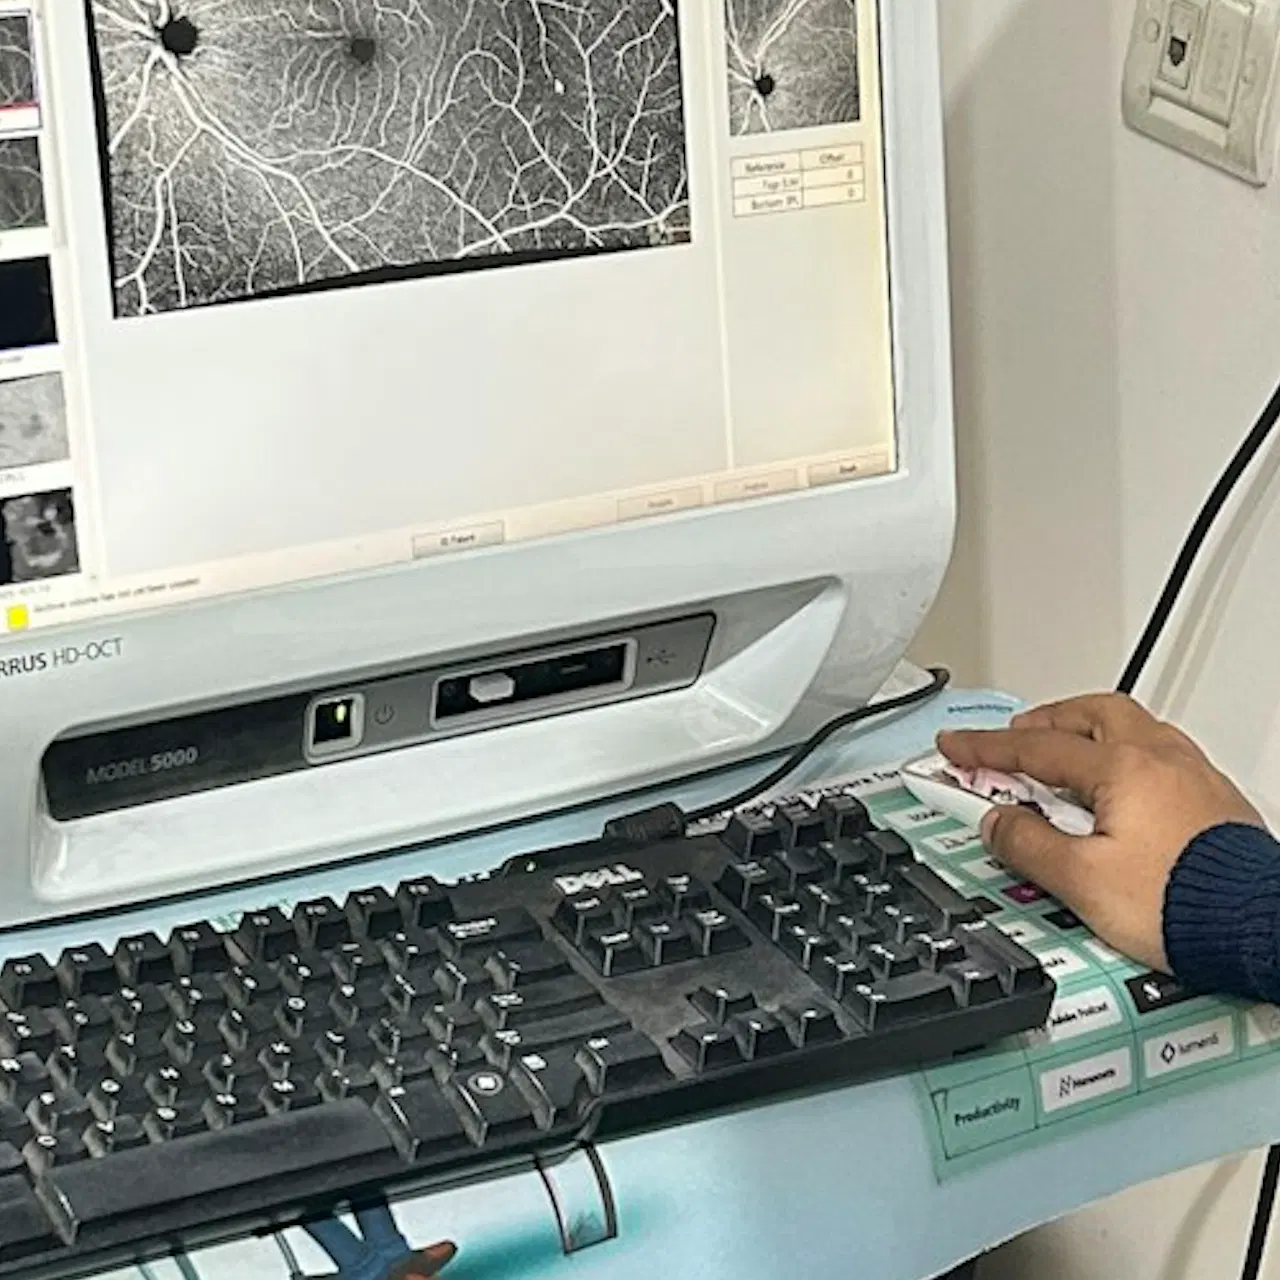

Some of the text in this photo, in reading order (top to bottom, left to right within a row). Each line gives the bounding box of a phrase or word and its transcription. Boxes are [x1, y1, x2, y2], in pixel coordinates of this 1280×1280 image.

[52, 636, 124, 669] HD-OCT
[86, 746, 199, 784] MODEL 5000
[553, 863, 644, 895] DELL
[954, 1096, 1020, 1126] Productivity
